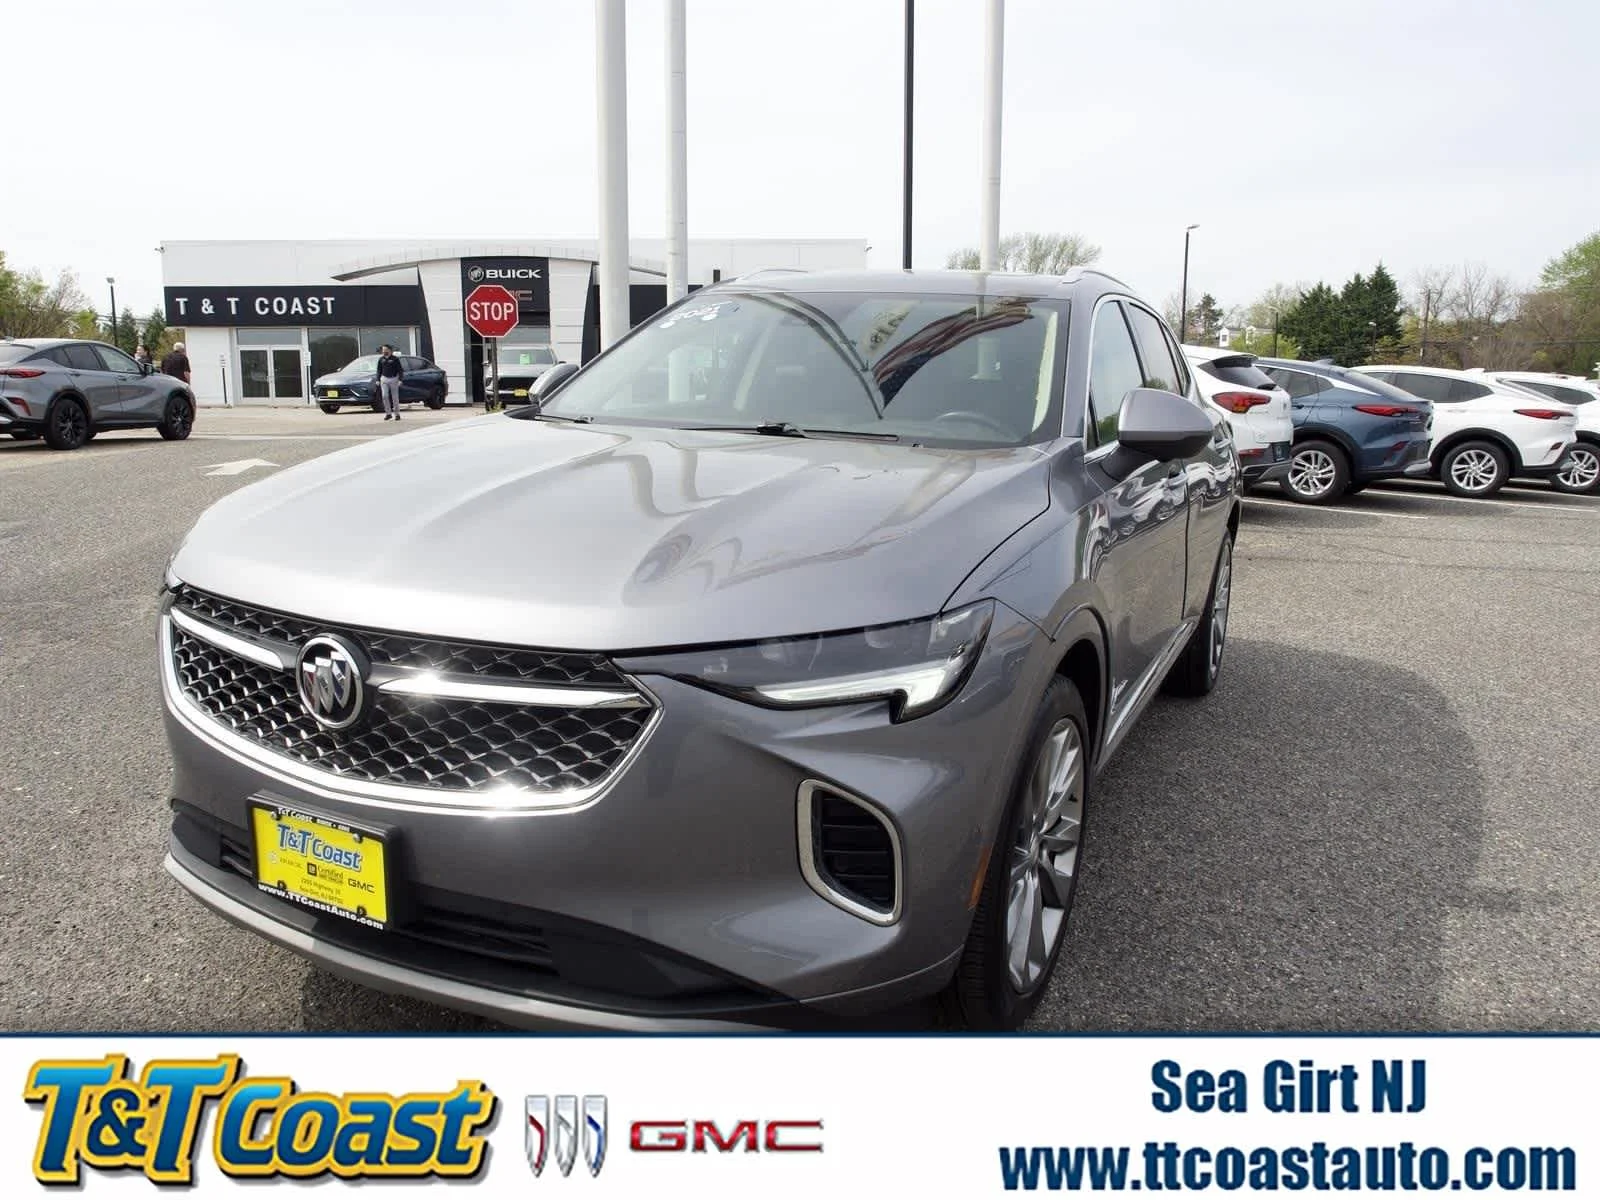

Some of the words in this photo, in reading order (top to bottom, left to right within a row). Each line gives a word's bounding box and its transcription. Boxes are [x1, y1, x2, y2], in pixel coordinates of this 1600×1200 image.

[485, 270, 542, 281] BUICK
[176, 297, 188, 314] T
[201, 298, 215, 314] &
[226, 298, 238, 314] T
[255, 297, 336, 315] COAST
[469, 302, 516, 322] STOP
[277, 824, 311, 857] T&T
[312, 839, 363, 872] Coast
[347, 878, 375, 894] GMC
[258, 883, 384, 930] www.TTCoastAuto.com
